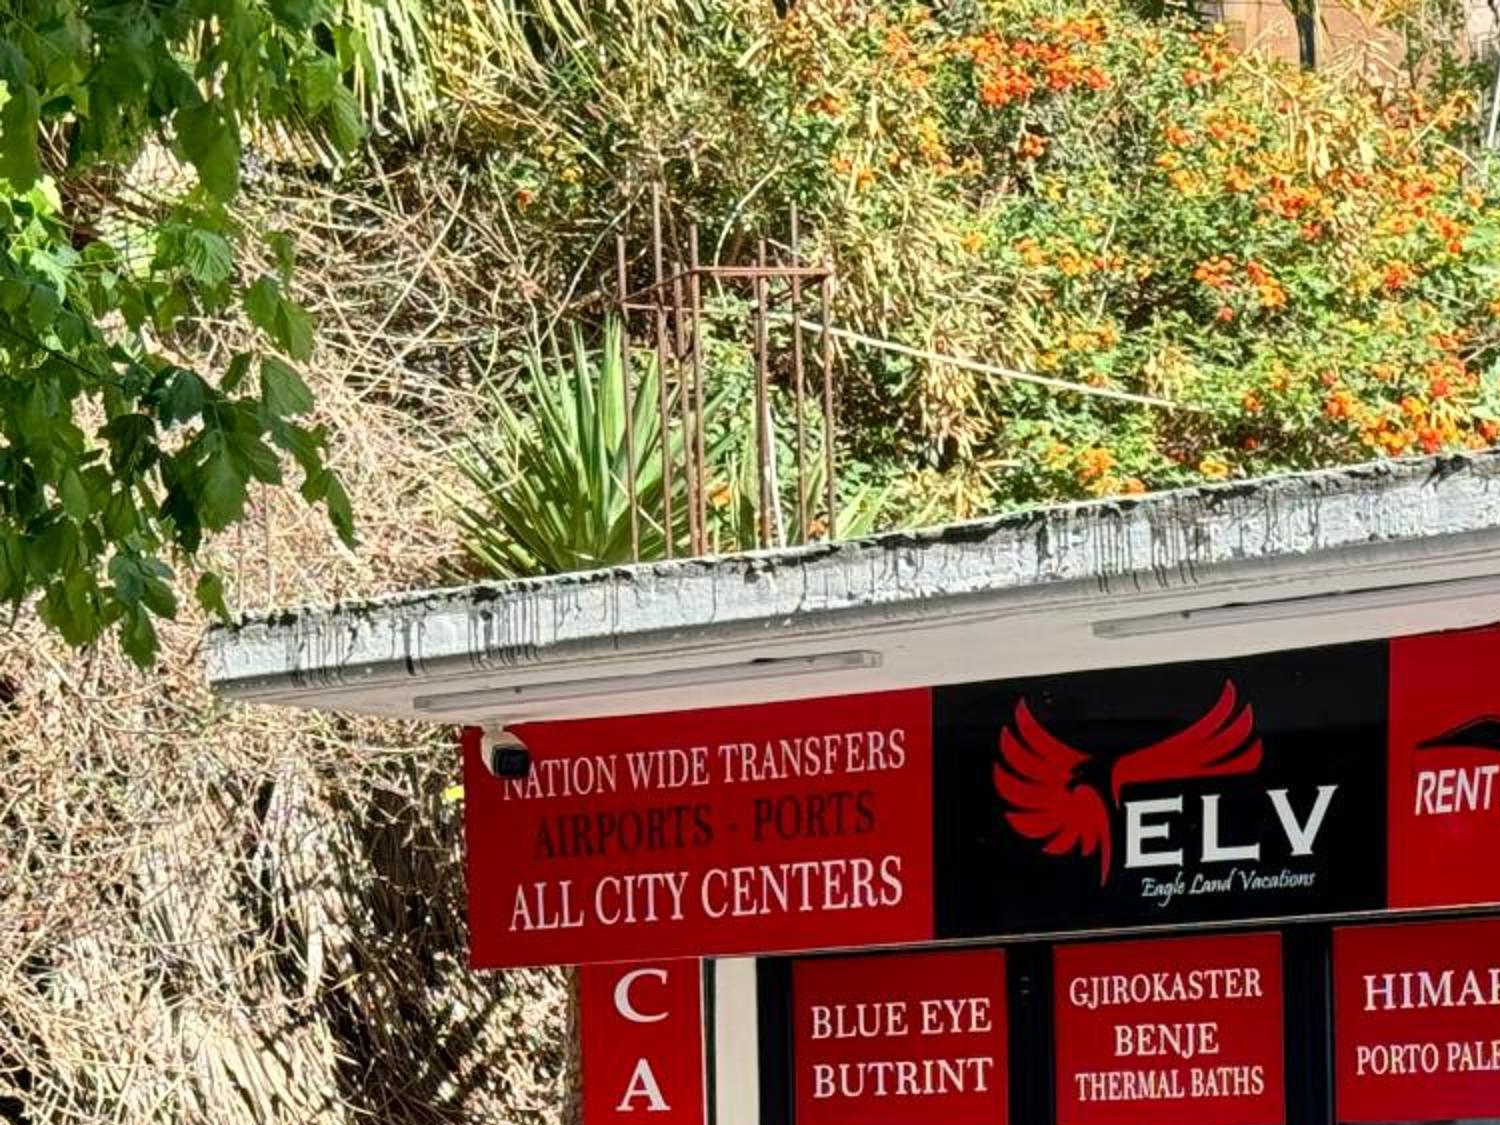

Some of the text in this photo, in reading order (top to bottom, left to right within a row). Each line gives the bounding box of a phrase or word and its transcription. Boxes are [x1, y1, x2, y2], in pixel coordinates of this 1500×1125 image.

[503, 729, 906, 801] NATION WIDE TRANSFERS
[1415, 765, 1500, 816] RENT
[536, 806, 712, 859] AIRPORTS
[753, 790, 876, 842] PORTS
[1124, 785, 1339, 868] ELV
[509, 856, 903, 931] ALL CITY CENTERS
[1142, 867, 1316, 907] Eagle Land Vacations
[1069, 967, 1263, 1009] GJIROKASTER
[811, 998, 992, 1039] BLUE EYE
[1114, 1023, 1219, 1059] BENJE
[1356, 1043, 1439, 1076] PORTO
[812, 1058, 993, 1098] BUTRINT
[1075, 1066, 1265, 1101] THERMAL BATHS
